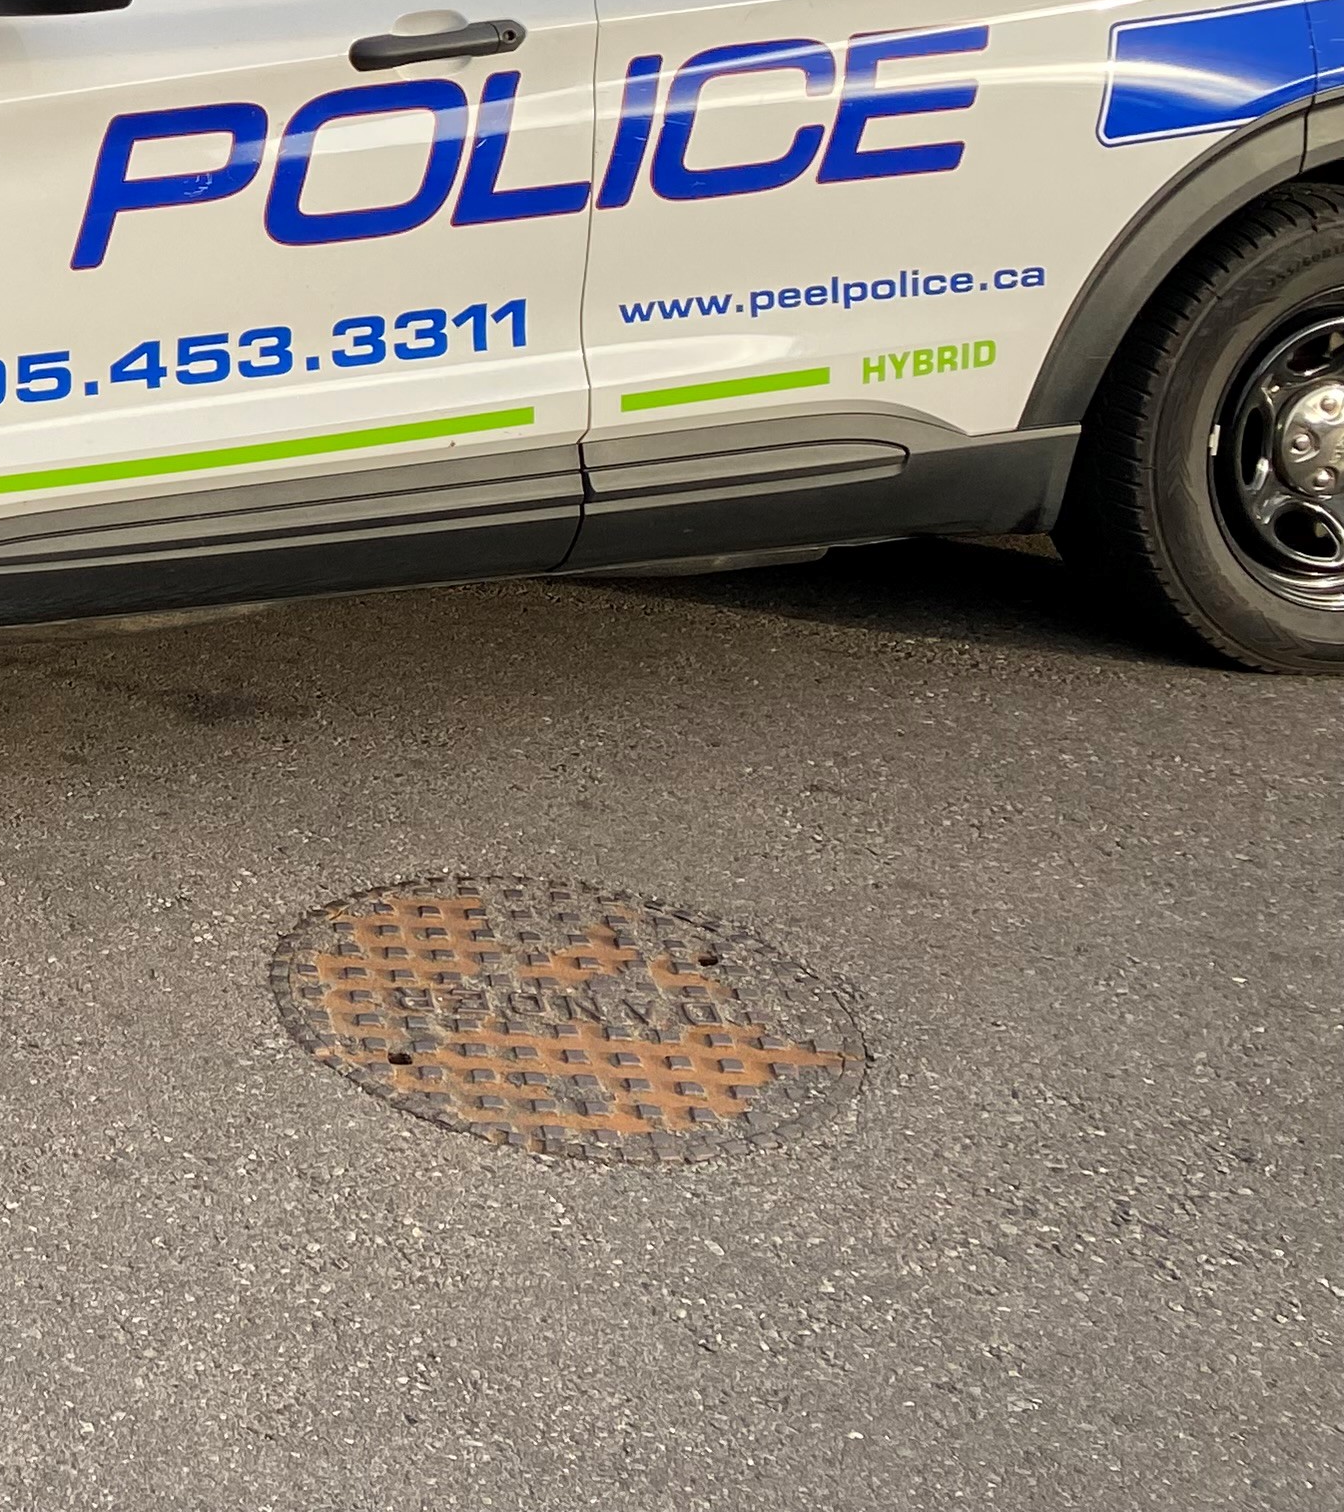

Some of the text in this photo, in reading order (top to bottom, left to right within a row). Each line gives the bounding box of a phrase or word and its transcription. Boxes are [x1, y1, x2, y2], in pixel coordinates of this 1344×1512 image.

[68, 24, 991, 271] POLICE
[618, 266, 1047, 324] www.peelpolice.ca
[861, 339, 997, 385] HYBRID
